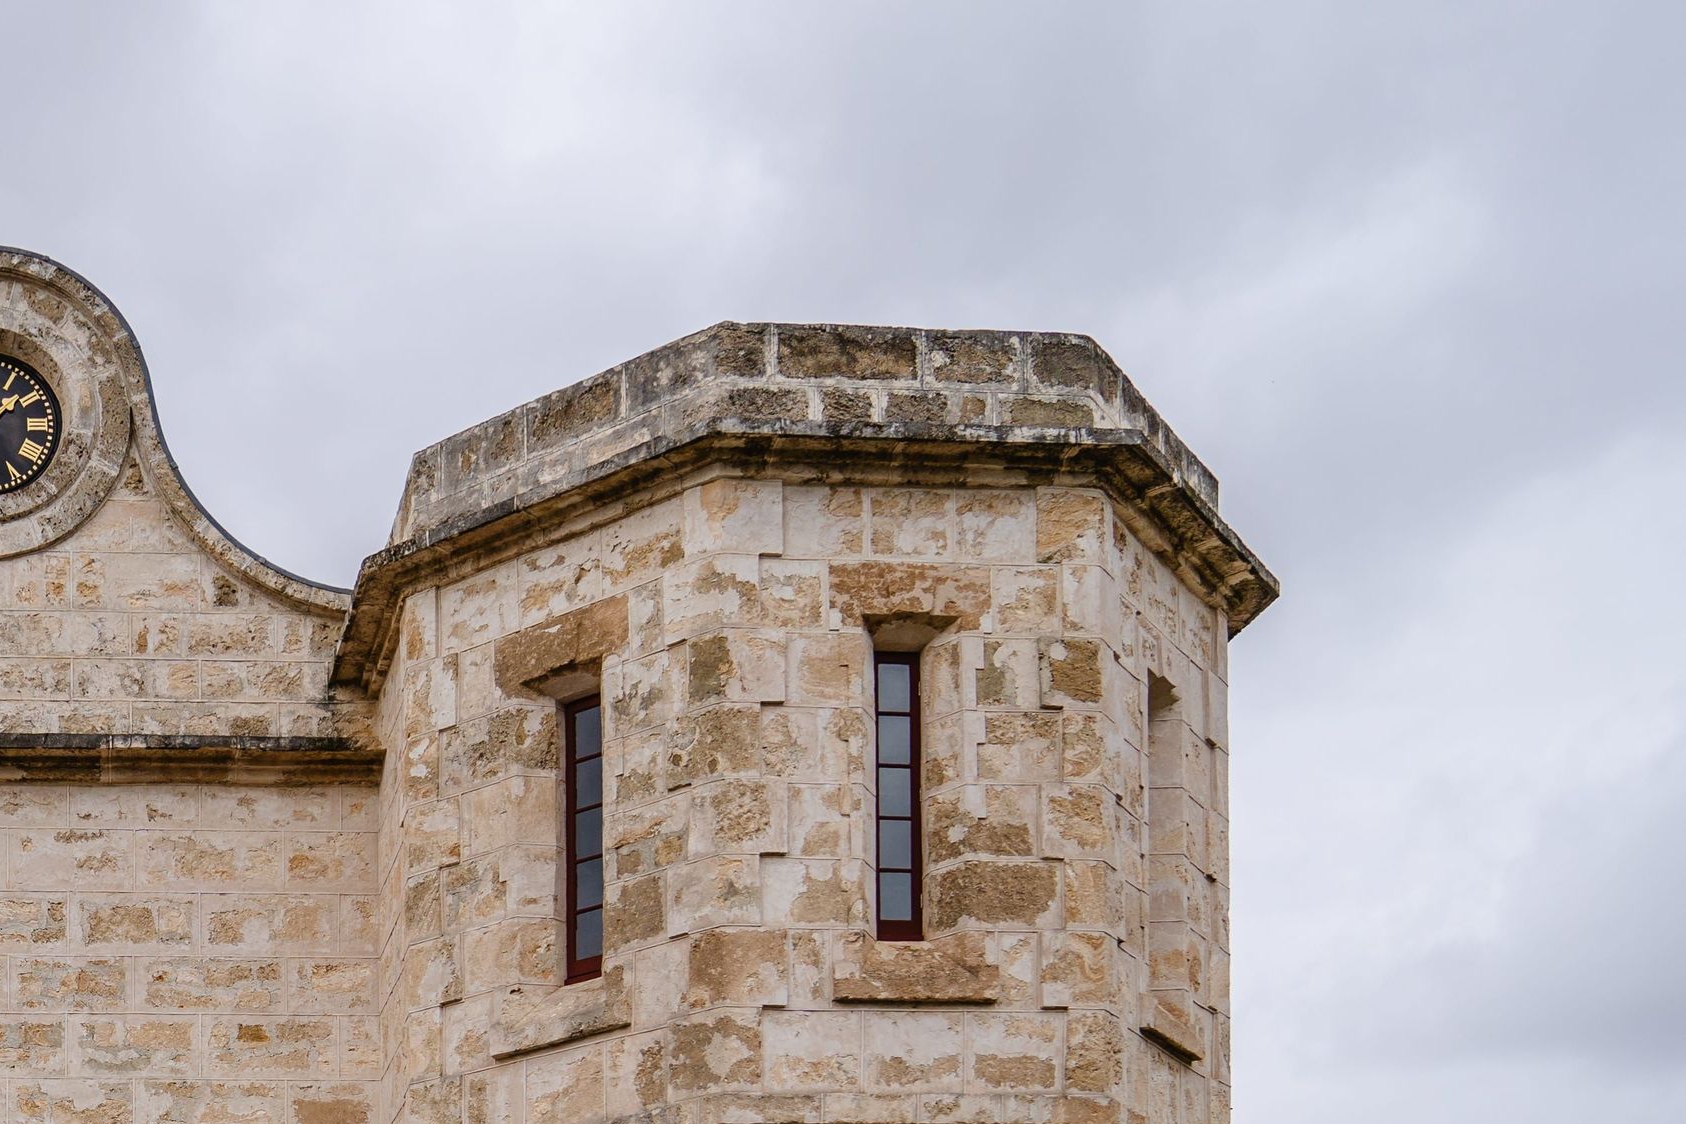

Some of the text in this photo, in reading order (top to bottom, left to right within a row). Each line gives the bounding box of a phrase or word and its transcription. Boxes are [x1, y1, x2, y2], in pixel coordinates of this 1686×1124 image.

[3, 371, 17, 391] I
[18, 390, 41, 408] II
[26, 417, 49, 431] III
[17, 438, 44, 463] IIII
[5, 460, 22, 480] V
